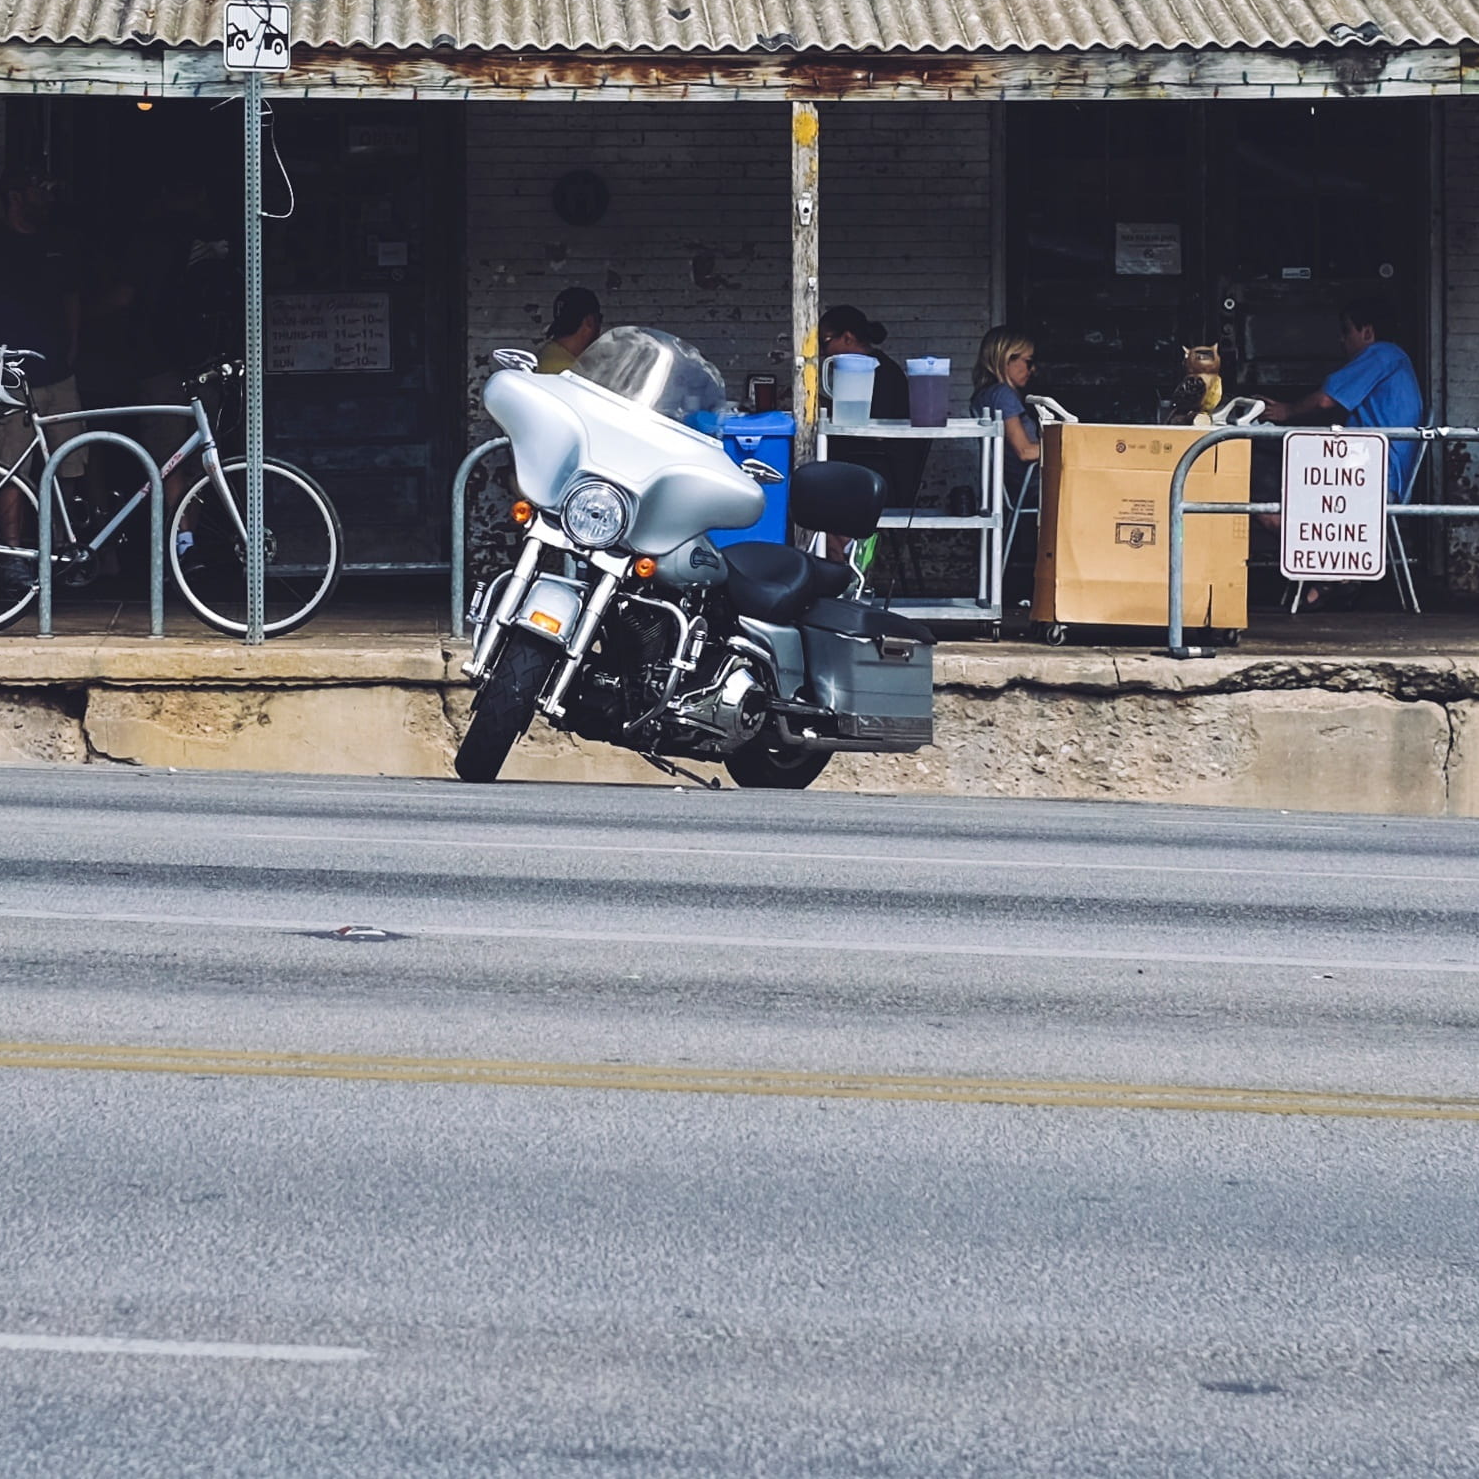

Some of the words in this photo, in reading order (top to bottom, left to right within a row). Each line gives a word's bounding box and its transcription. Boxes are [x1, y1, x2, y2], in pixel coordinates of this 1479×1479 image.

[1323, 440, 1348, 458] NO
[1304, 467, 1365, 487] IDLING
[1322, 495, 1346, 514] NO
[1300, 522, 1368, 542] ENGINE
[1293, 550, 1372, 571] REVVING
